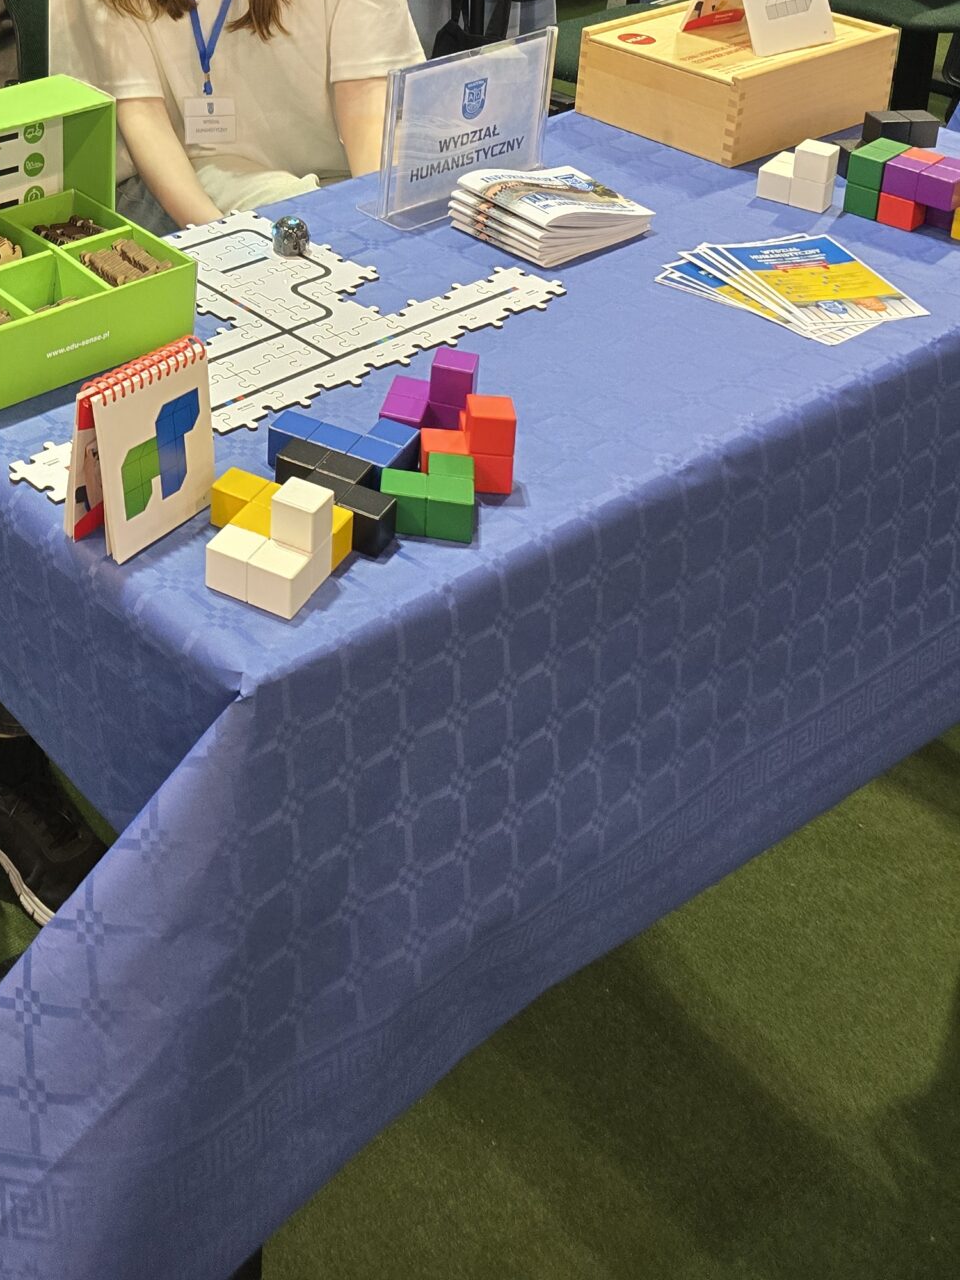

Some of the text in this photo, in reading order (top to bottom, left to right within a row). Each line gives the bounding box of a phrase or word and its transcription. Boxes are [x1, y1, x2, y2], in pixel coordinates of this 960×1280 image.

[438, 124, 500, 153] WYDZIAŁ
[409, 136, 525, 183] HUMANISTYCZNY
[46, 330, 110, 359] www.edu-sense.pl
